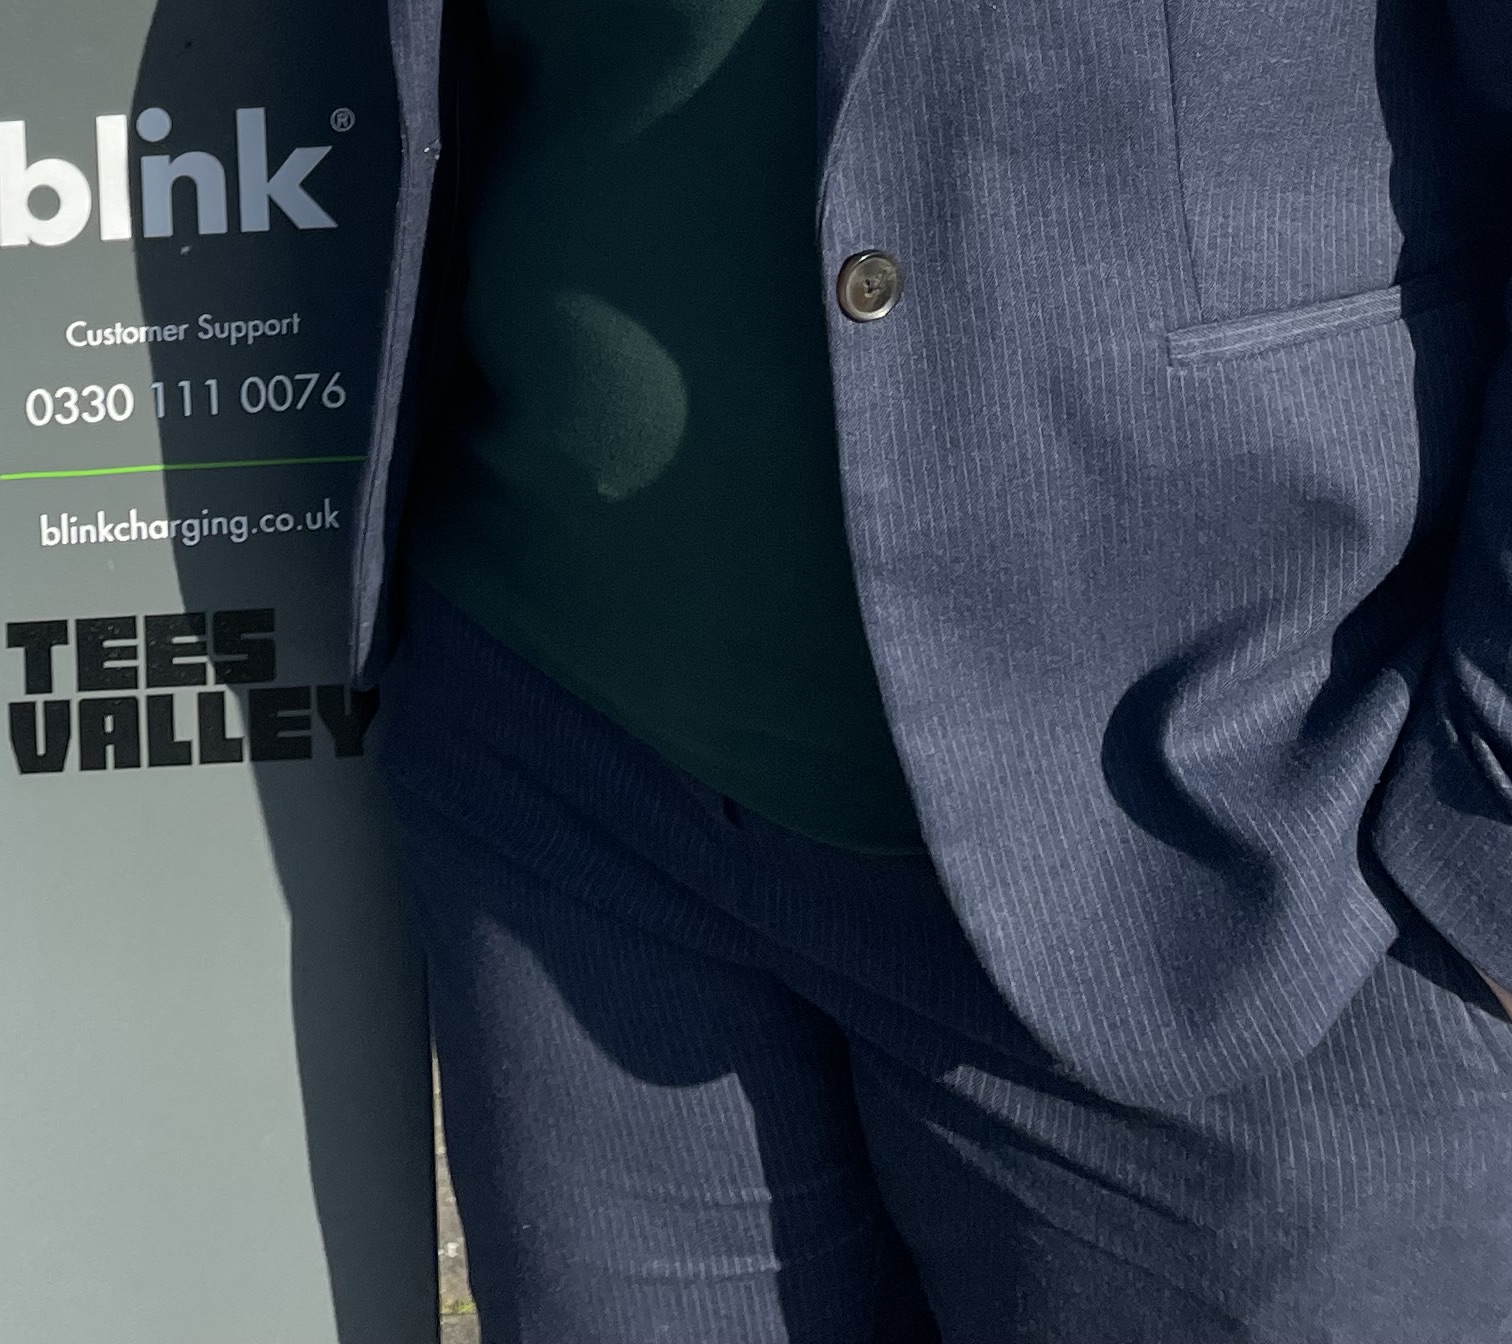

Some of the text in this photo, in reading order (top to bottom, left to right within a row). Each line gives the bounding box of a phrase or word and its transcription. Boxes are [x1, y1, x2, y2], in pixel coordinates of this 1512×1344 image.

[65, 312, 302, 348] Customer Support
[25, 371, 347, 427] 0330 111 0076
[39, 498, 341, 547] blinkcharging.co.uk
[5, 608, 277, 695] TEES
[8, 683, 381, 775] VALLEY
